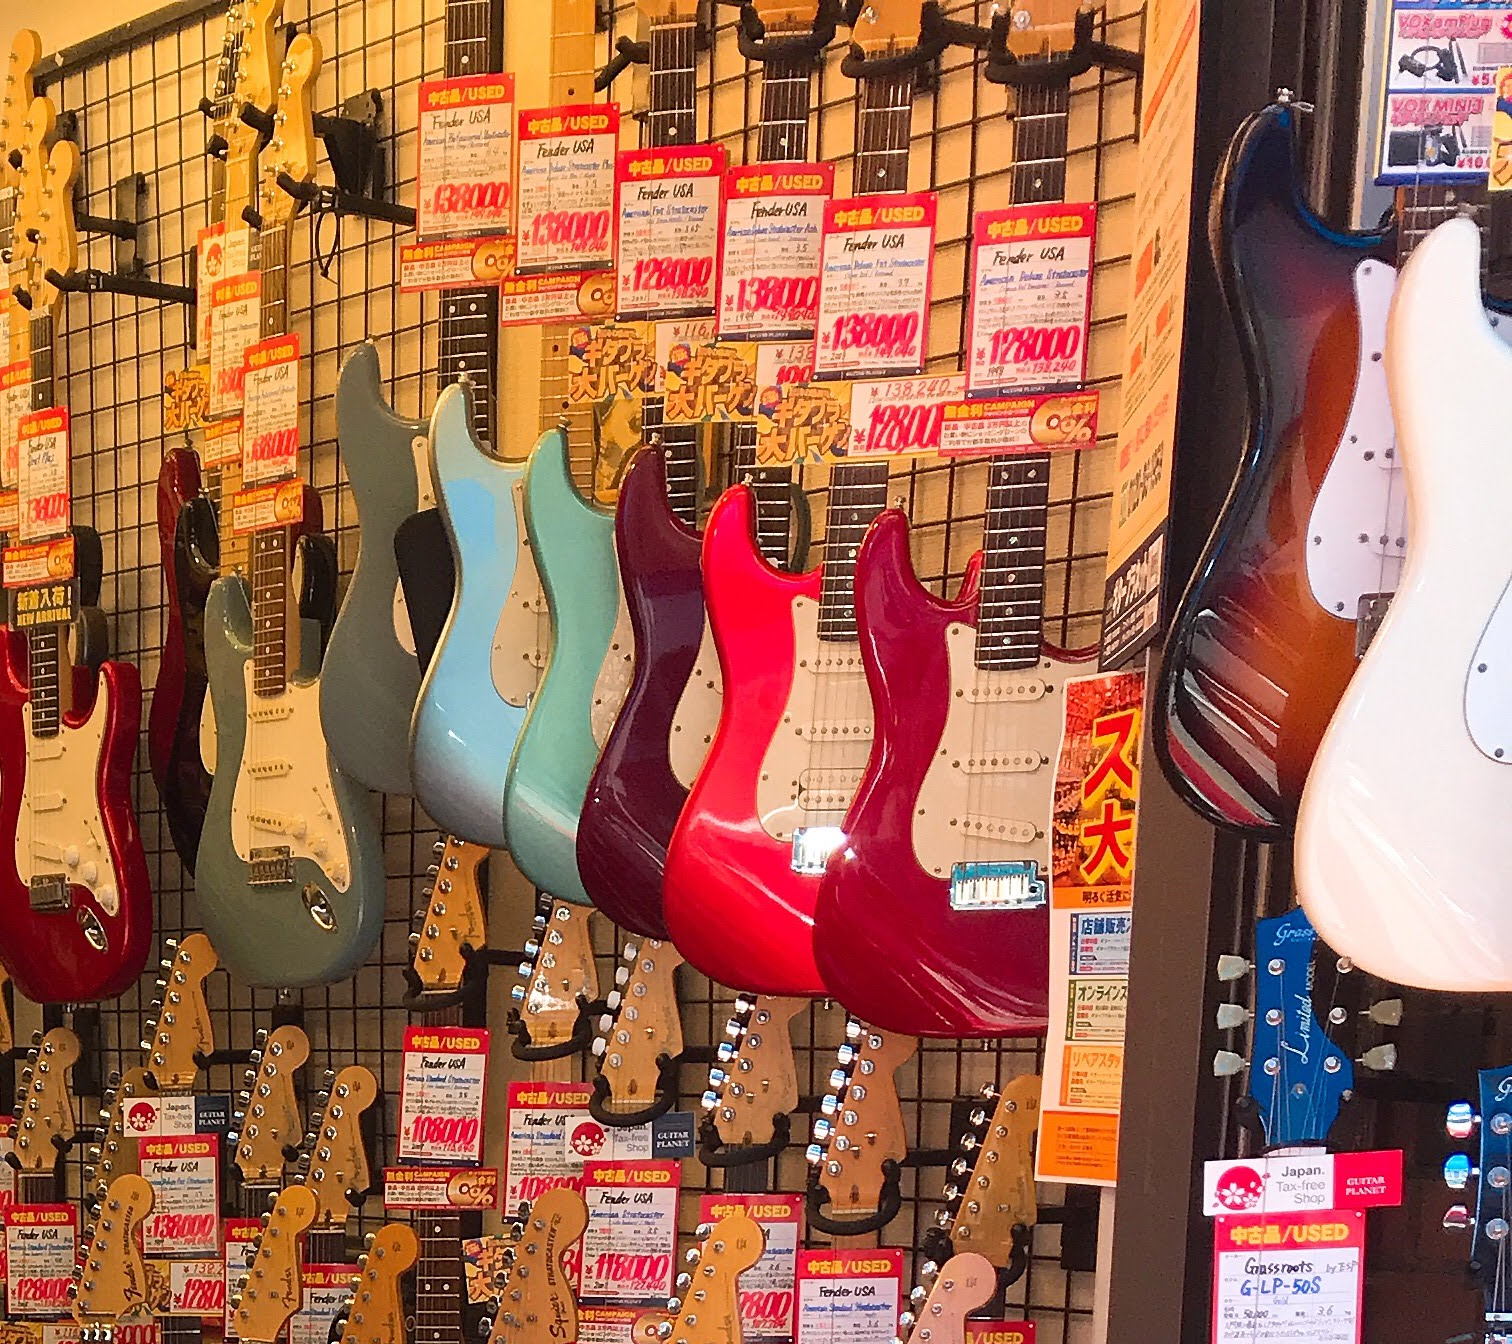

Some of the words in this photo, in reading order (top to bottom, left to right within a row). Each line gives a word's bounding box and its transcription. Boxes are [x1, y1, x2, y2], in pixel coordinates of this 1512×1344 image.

[428, 84, 505, 105] 中古品/USED
[469, 107, 491, 125] USA
[528, 115, 609, 133] 中古品/USED
[536, 140, 570, 159] Fender
[572, 139, 595, 154] USA
[629, 156, 713, 175] 中古品/USED
[637, 185, 669, 201] Fender
[673, 182, 694, 198] USA
[736, 175, 823, 193] 中古品/USED
[750, 201, 785, 219] Fender
[785, 201, 807, 216] USA
[834, 206, 925, 227] 中古品/USED
[531, 210, 610, 246] 138000
[988, 215, 1083, 239] 中古品/USED
[843, 234, 877, 252] Fender
[882, 234, 905, 248] USA
[992, 248, 1033, 267] Fender
[1040, 247, 1065, 262] USA
[633, 256, 713, 291] 128000
[831, 311, 919, 352] 138000
[989, 325, 1081, 365] 128000
[984, 400, 1035, 410] CAMPAIGN
[1280, 994, 1313, 1065] Limited
[412, 1036, 480, 1050] 中古品/USED
[420, 1057, 447, 1070] Fender
[448, 1057, 466, 1070] USA
[412, 1115, 479, 1145] 108000
[658, 1130, 689, 1140] GUITAR
[145, 1143, 209, 1156] 中古品/USED
[656, 1139, 690, 1148] PLANET
[152, 1160, 178, 1173] Fender
[181, 1161, 199, 1172] USA
[1281, 1166, 1325, 1178] Japan.
[593, 1169, 671, 1183] 中古品/USED
[1346, 1176, 1385, 1185] GUITAR
[1275, 1180, 1325, 1192] Tax-free
[1345, 1186, 1386, 1196] PLANET
[599, 1191, 630, 1205] Fender
[634, 1192, 653, 1204] USA
[1294, 1192, 1325, 1205] Shop
[10, 1211, 69, 1223] 中古品/USED
[42, 1229, 58, 1239] USA
[1230, 1223, 1349, 1245] 中古品/USED
[594, 1253, 670, 1282] 118000
[808, 1260, 891, 1273] 中古品/USED
[1244, 1257, 1314, 1275] Grassroots
[819, 1286, 852, 1297] Fender
[854, 1285, 875, 1296] USA
[1240, 1276, 1322, 1296] G-LP-50S
